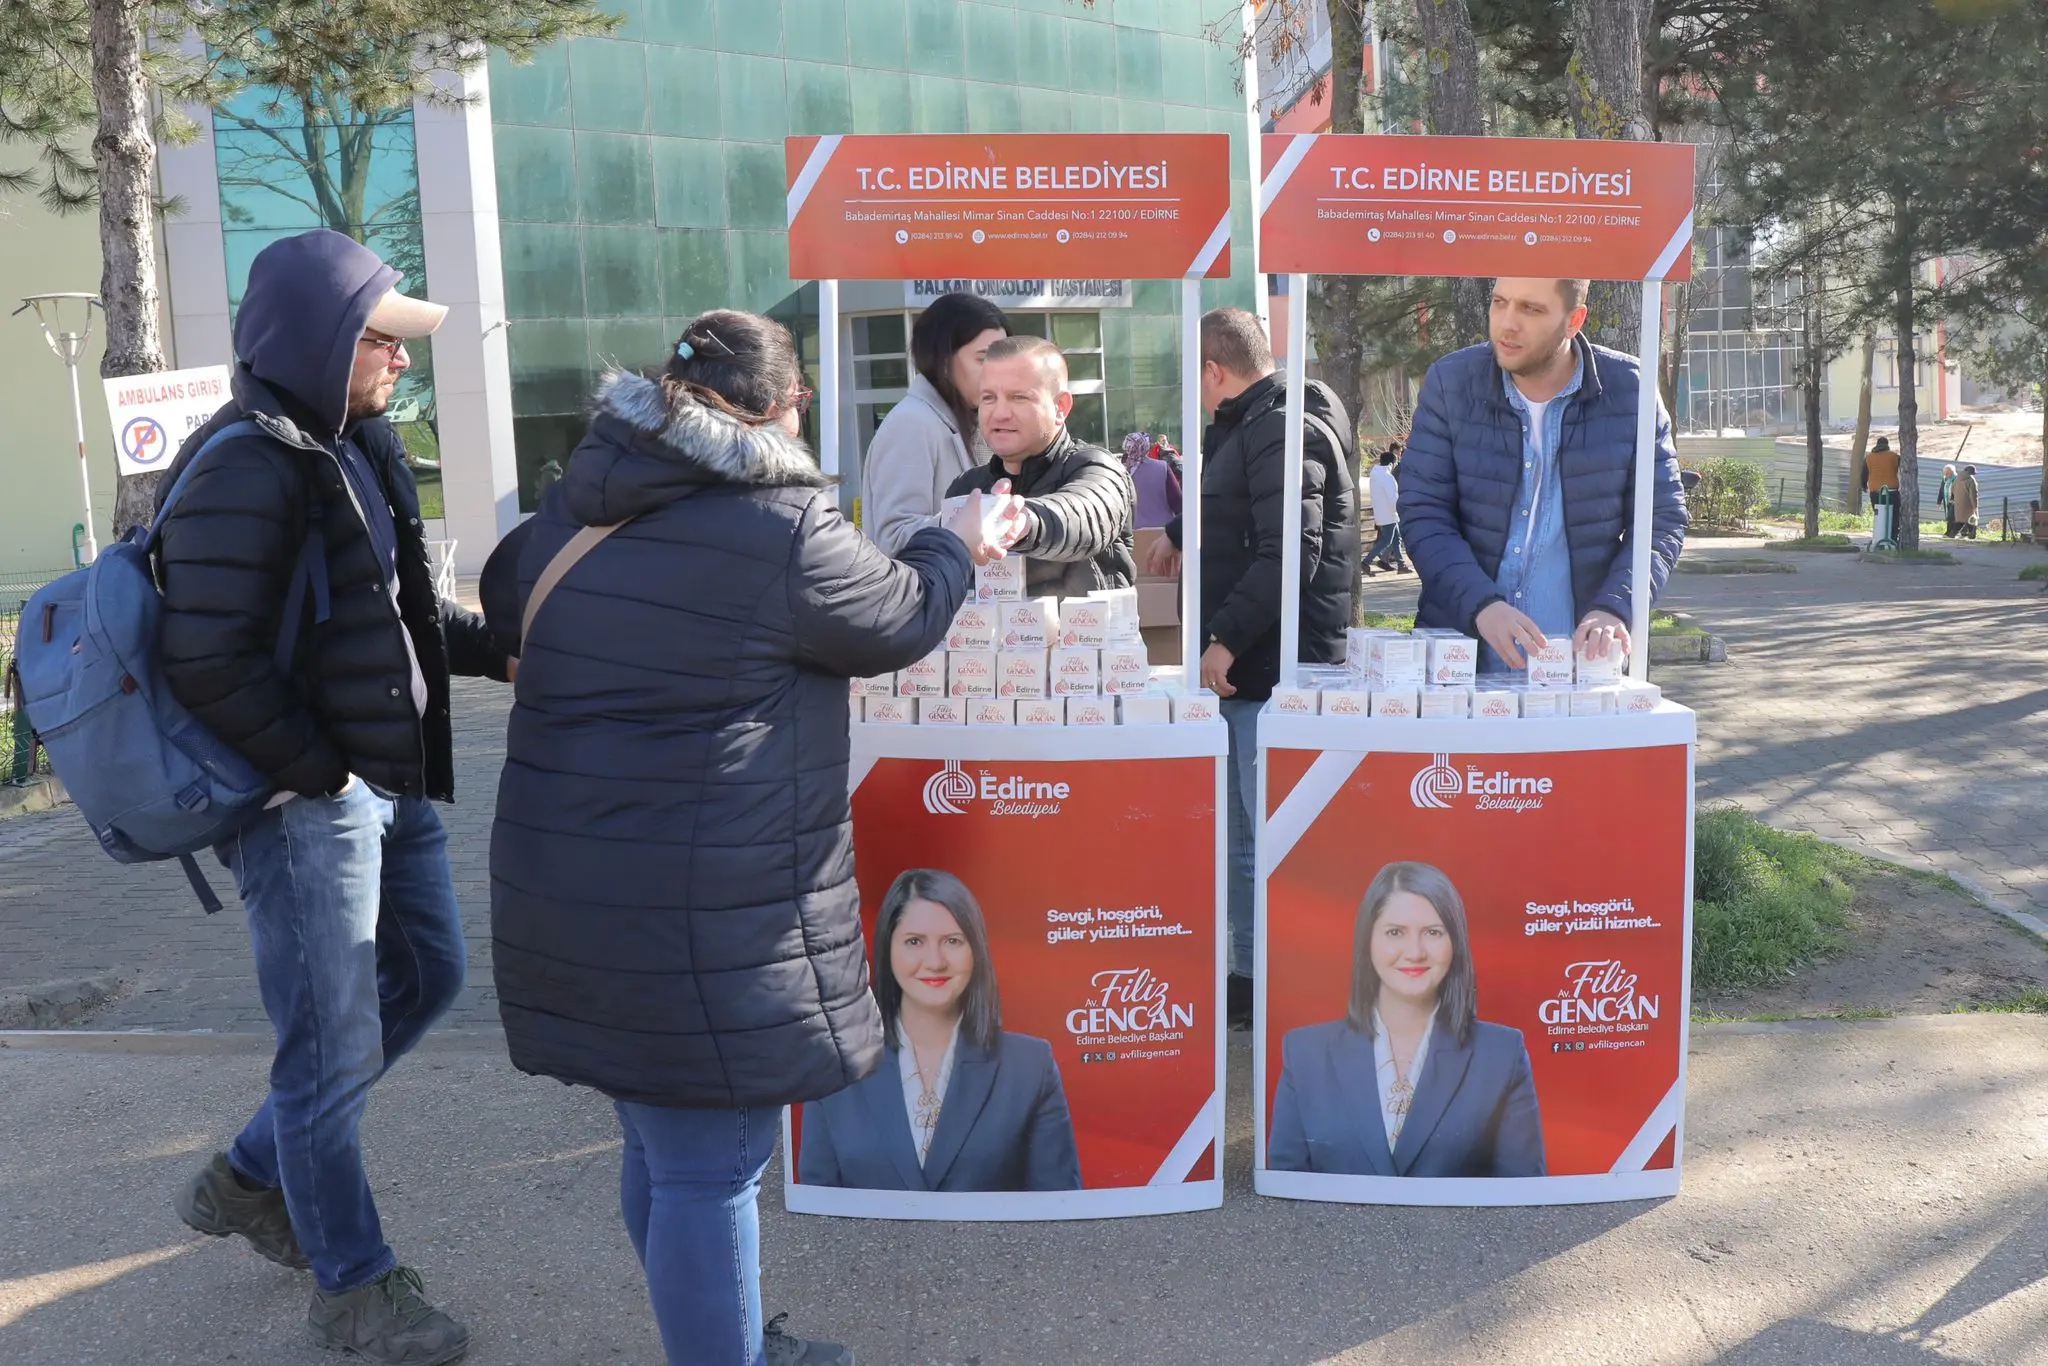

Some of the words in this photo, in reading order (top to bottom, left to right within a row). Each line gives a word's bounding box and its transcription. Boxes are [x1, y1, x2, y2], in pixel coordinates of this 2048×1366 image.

[856, 167, 902, 190] T.C.
[908, 161, 1008, 190] EDİRNE
[1016, 160, 1168, 189] BELEDİYESİ
[1330, 167, 1376, 190] T.C.
[1383, 162, 1480, 192] EDİRNE
[1488, 166, 1632, 196] BELEDİYESİ
[845, 211, 912, 223] Babademirtaş
[914, 210, 960, 221] Mahallesi
[963, 210, 995, 220] Mimar
[997, 210, 1025, 220] Sinan
[1027, 210, 1068, 220] Caddesi
[1072, 210, 1096, 220] No:1
[1098, 210, 1131, 220] 22100
[1140, 208, 1180, 220] EDİRNE
[1317, 208, 1385, 222] Babademirtaş
[1387, 210, 1432, 221] Mahallesi
[1435, 210, 1466, 222] Mimar
[1468, 211, 1494, 222] Sinan
[1498, 212, 1537, 223] Caddesi
[1540, 214, 1562, 224] No:1
[1566, 214, 1596, 225] 22100
[1604, 214, 1640, 226] EDİRNE
[118, 383, 184, 407] AMBULANS
[186, 413, 213, 430] PAR
[994, 588, 1018, 596] Edirne
[966, 637, 990, 646] Edirne
[1020, 634, 1044, 642] Edirne
[1452, 670, 1473, 678] Edirne
[865, 683, 890, 691] Edirne
[916, 684, 940, 692] Edirne
[968, 685, 992, 693] Edirne
[1016, 686, 1040, 694] Edirne
[980, 776, 1070, 800] Edirne
[1467, 771, 1553, 794] Edirne
[990, 800, 1060, 818] Belediyesi
[1476, 794, 1544, 814] Belediyesi
[1047, 908, 1095, 925] Sevgi,
[1097, 905, 1163, 924] hoşgörü,
[1526, 900, 1571, 917] Sevgi,
[1574, 898, 1634, 916] hoşgörü,
[1047, 927, 1086, 944] güler
[1090, 925, 1129, 943] yüzlü
[1132, 922, 1192, 937] hizmet...
[1524, 919, 1562, 936] güler
[1565, 918, 1602, 934] yüzlü
[1605, 915, 1662, 930] hizmet...
[1564, 958, 1638, 1008] Filiz
[1091, 966, 1169, 1018] Filiz
[1558, 989, 1571, 998] Av.
[1085, 998, 1098, 1008] Av.
[1538, 994, 1659, 1024] GENCAN
[1066, 1002, 1194, 1034] GENCAN
[1548, 1026, 1575, 1036] Edirne
[1577, 1024, 1614, 1035] Belediye
[1616, 1022, 1649, 1033] Başkanı
[1076, 1036, 1106, 1046] Edirne
[1108, 1034, 1146, 1044] Belediye
[1149, 1031, 1184, 1042] Başkanı
[1588, 1039, 1646, 1050] avfilizgencan
[1120, 1049, 1180, 1060] avfilizgencan
